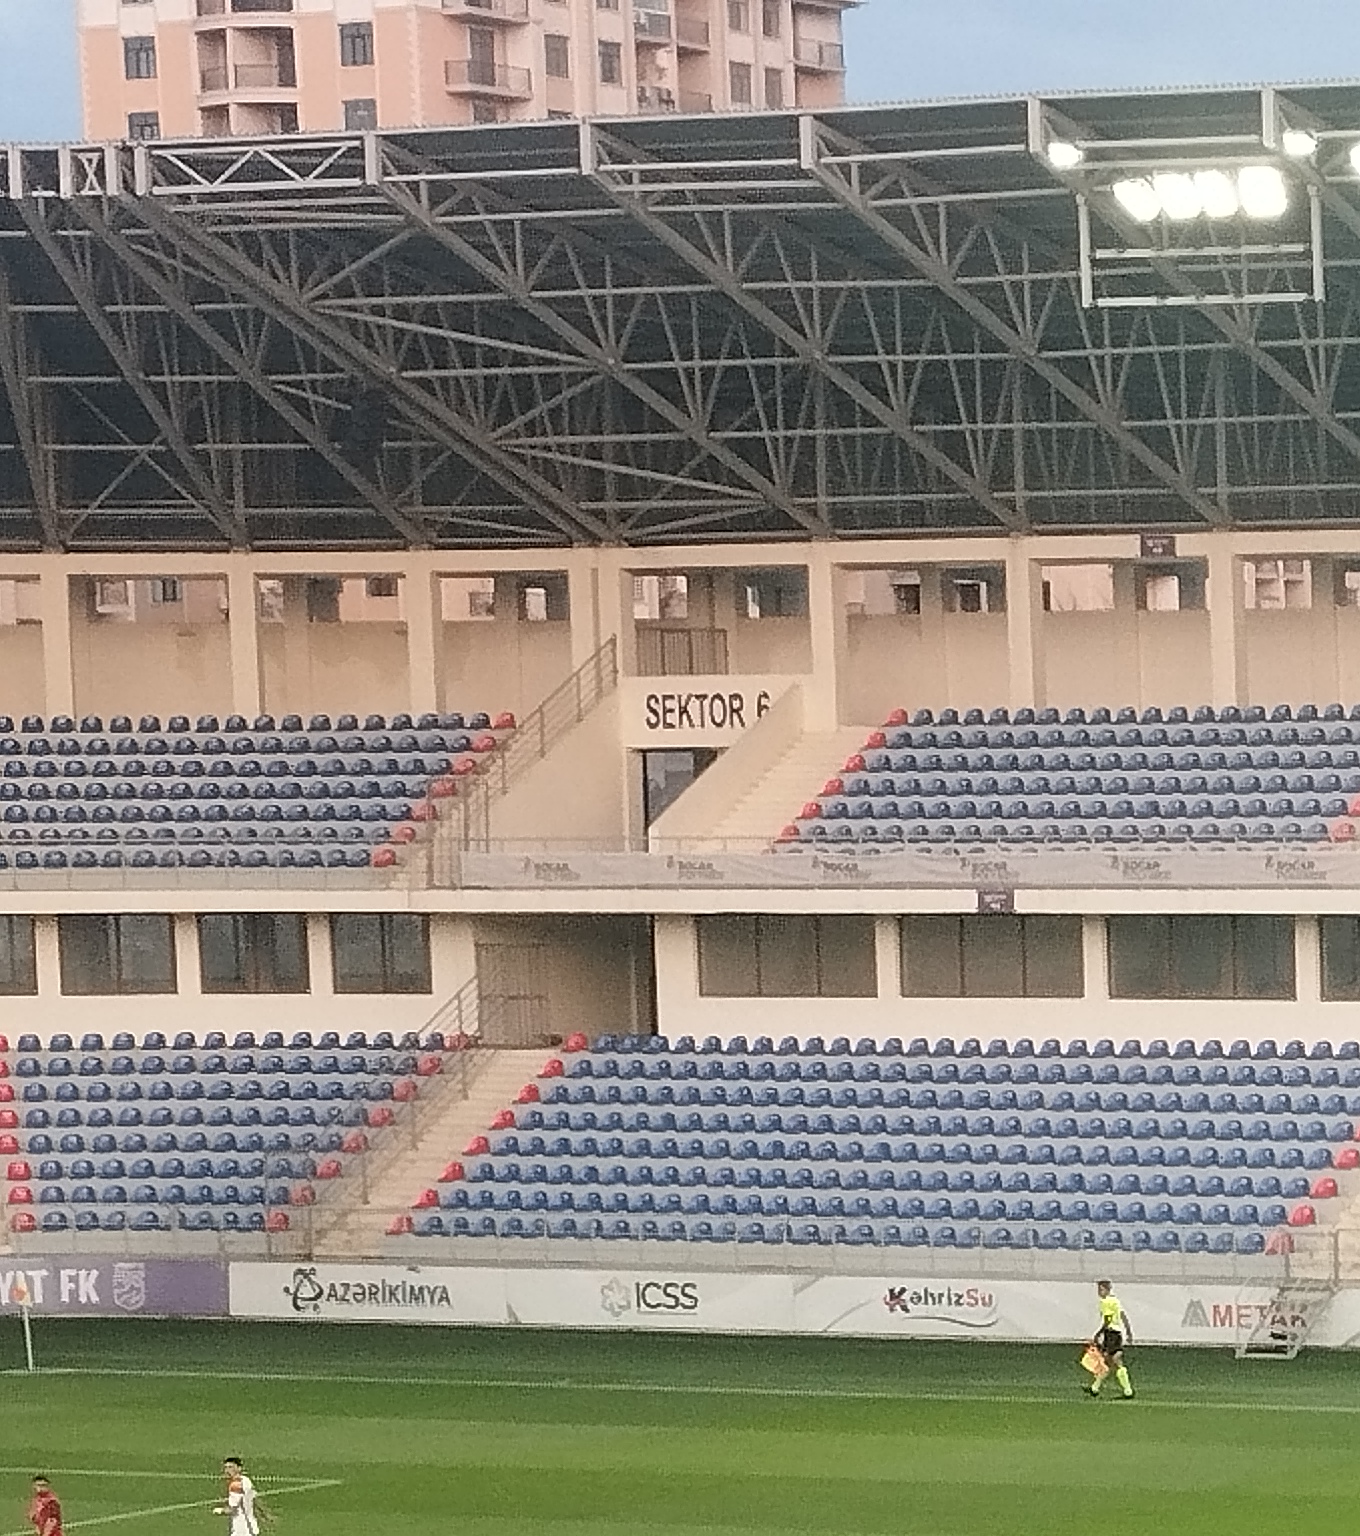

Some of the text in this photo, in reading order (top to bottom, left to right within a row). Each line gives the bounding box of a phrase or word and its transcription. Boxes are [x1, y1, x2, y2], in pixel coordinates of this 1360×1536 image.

[645, 693, 746, 730] SEKTOR
[60, 1268, 100, 1305] FK
[635, 1282, 699, 1310] ICSS
